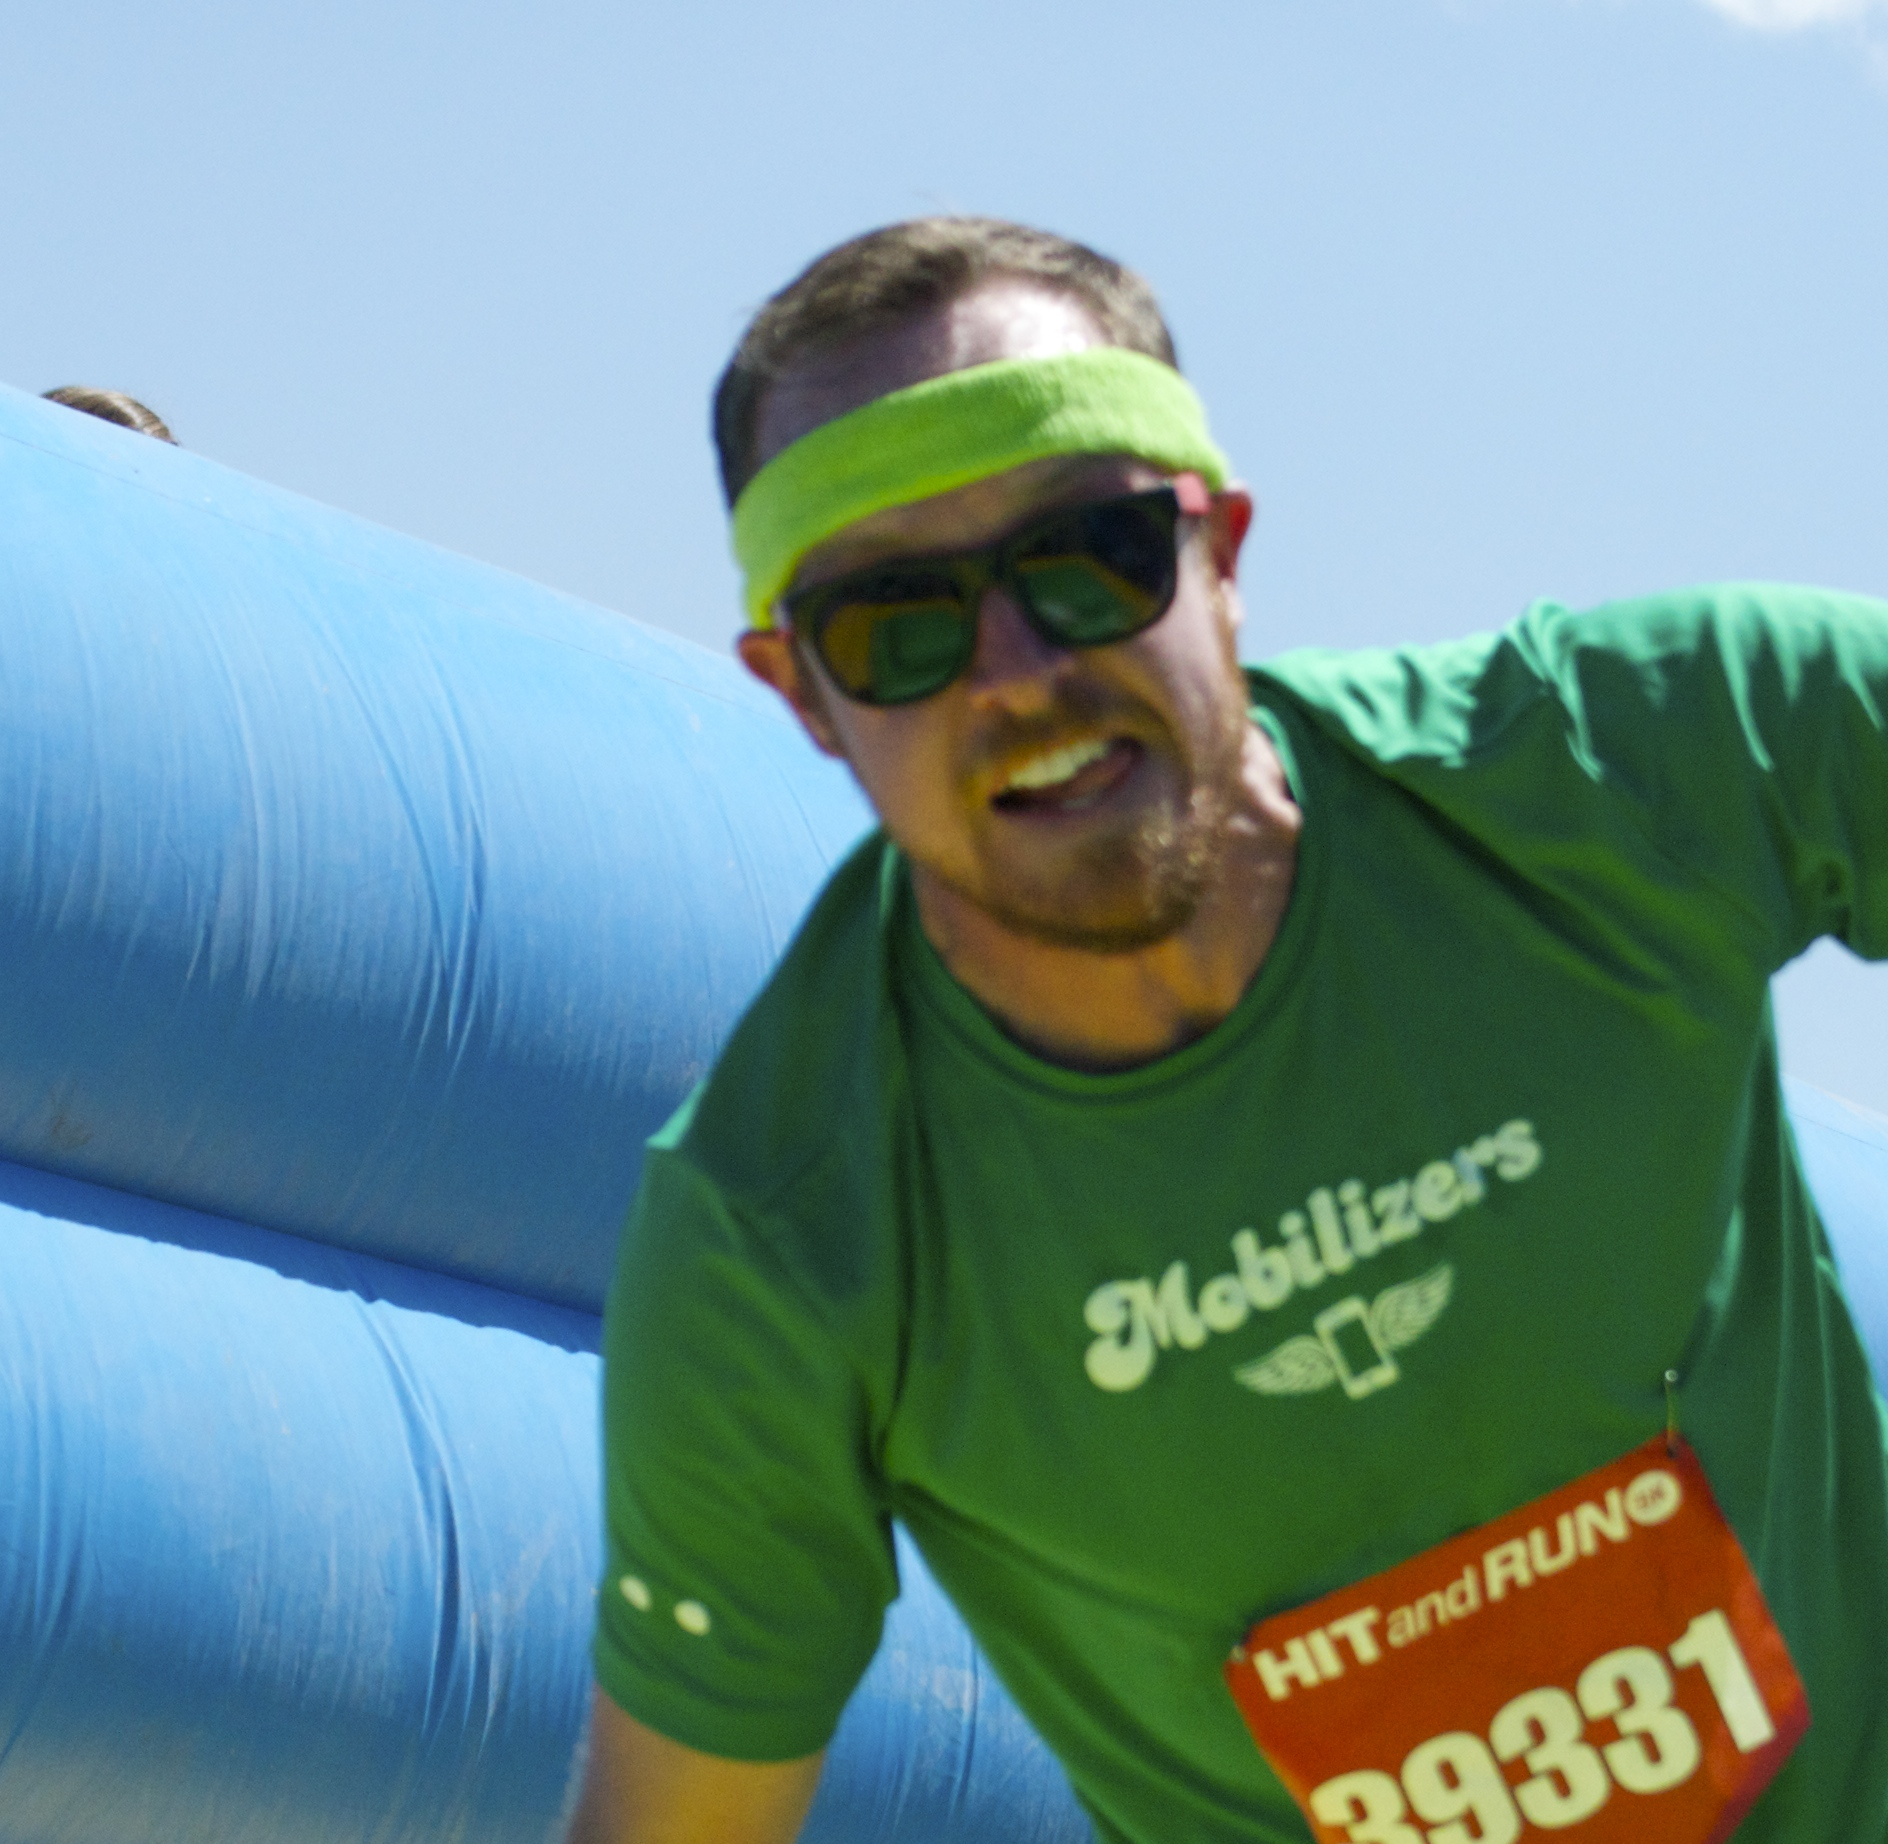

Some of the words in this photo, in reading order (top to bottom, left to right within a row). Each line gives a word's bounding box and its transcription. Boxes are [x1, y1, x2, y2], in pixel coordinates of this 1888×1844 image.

[1084, 1121, 1541, 1391] Mobilizers
[1252, 1606, 1381, 1701] HIT
[1386, 1566, 1481, 1647] and
[1483, 1487, 1630, 1601] RUN
